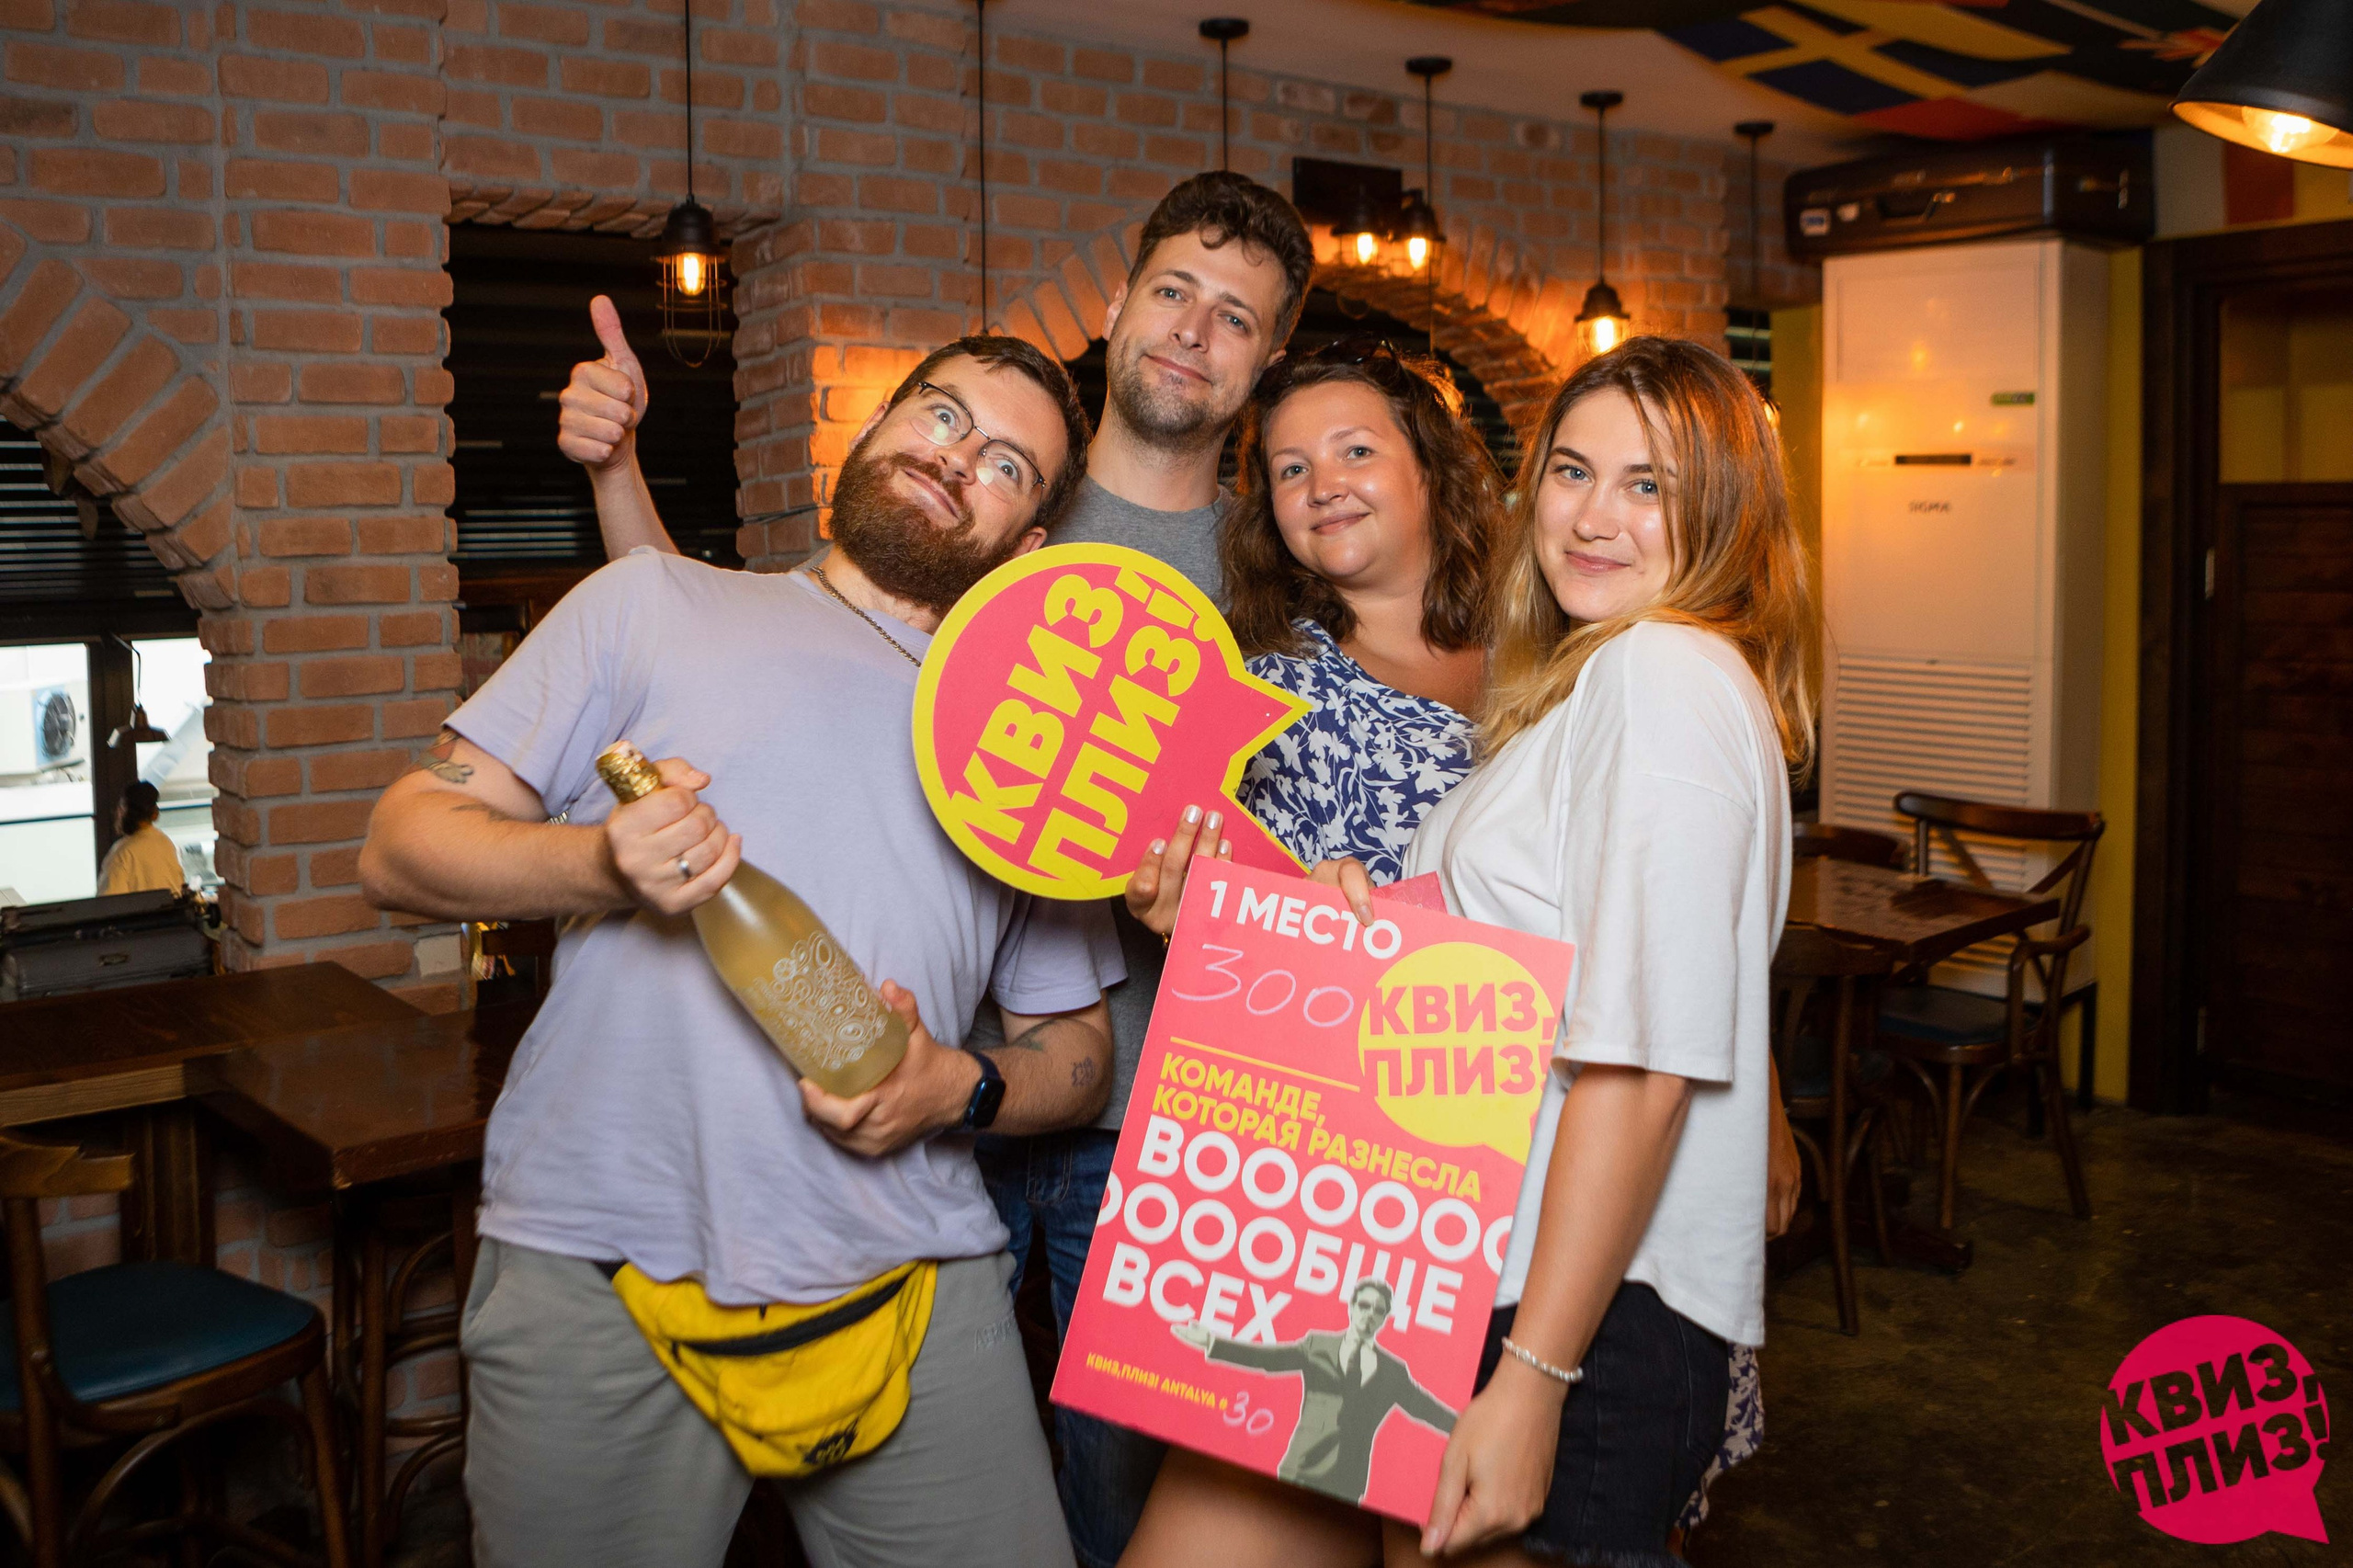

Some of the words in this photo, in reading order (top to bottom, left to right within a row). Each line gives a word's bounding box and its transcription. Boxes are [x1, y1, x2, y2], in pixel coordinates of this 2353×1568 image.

[1027, 588, 1214, 881] ПЛИЗ!
[1210, 880, 1228, 919] 1
[1236, 886, 1403, 960] МЕСТО
[1171, 943, 1355, 1028] 300
[1159, 1051, 1326, 1129] КОМАНДЕ,
[1151, 1084, 1302, 1152] КОТОРАЯ
[1307, 1127, 1482, 1202] РАЗНЕСЛА
[1102, 1241, 1293, 1346] ВСЕХ
[1160, 1377, 1216, 1411] ANTALYA
[1222, 1391, 1275, 1436] 30
